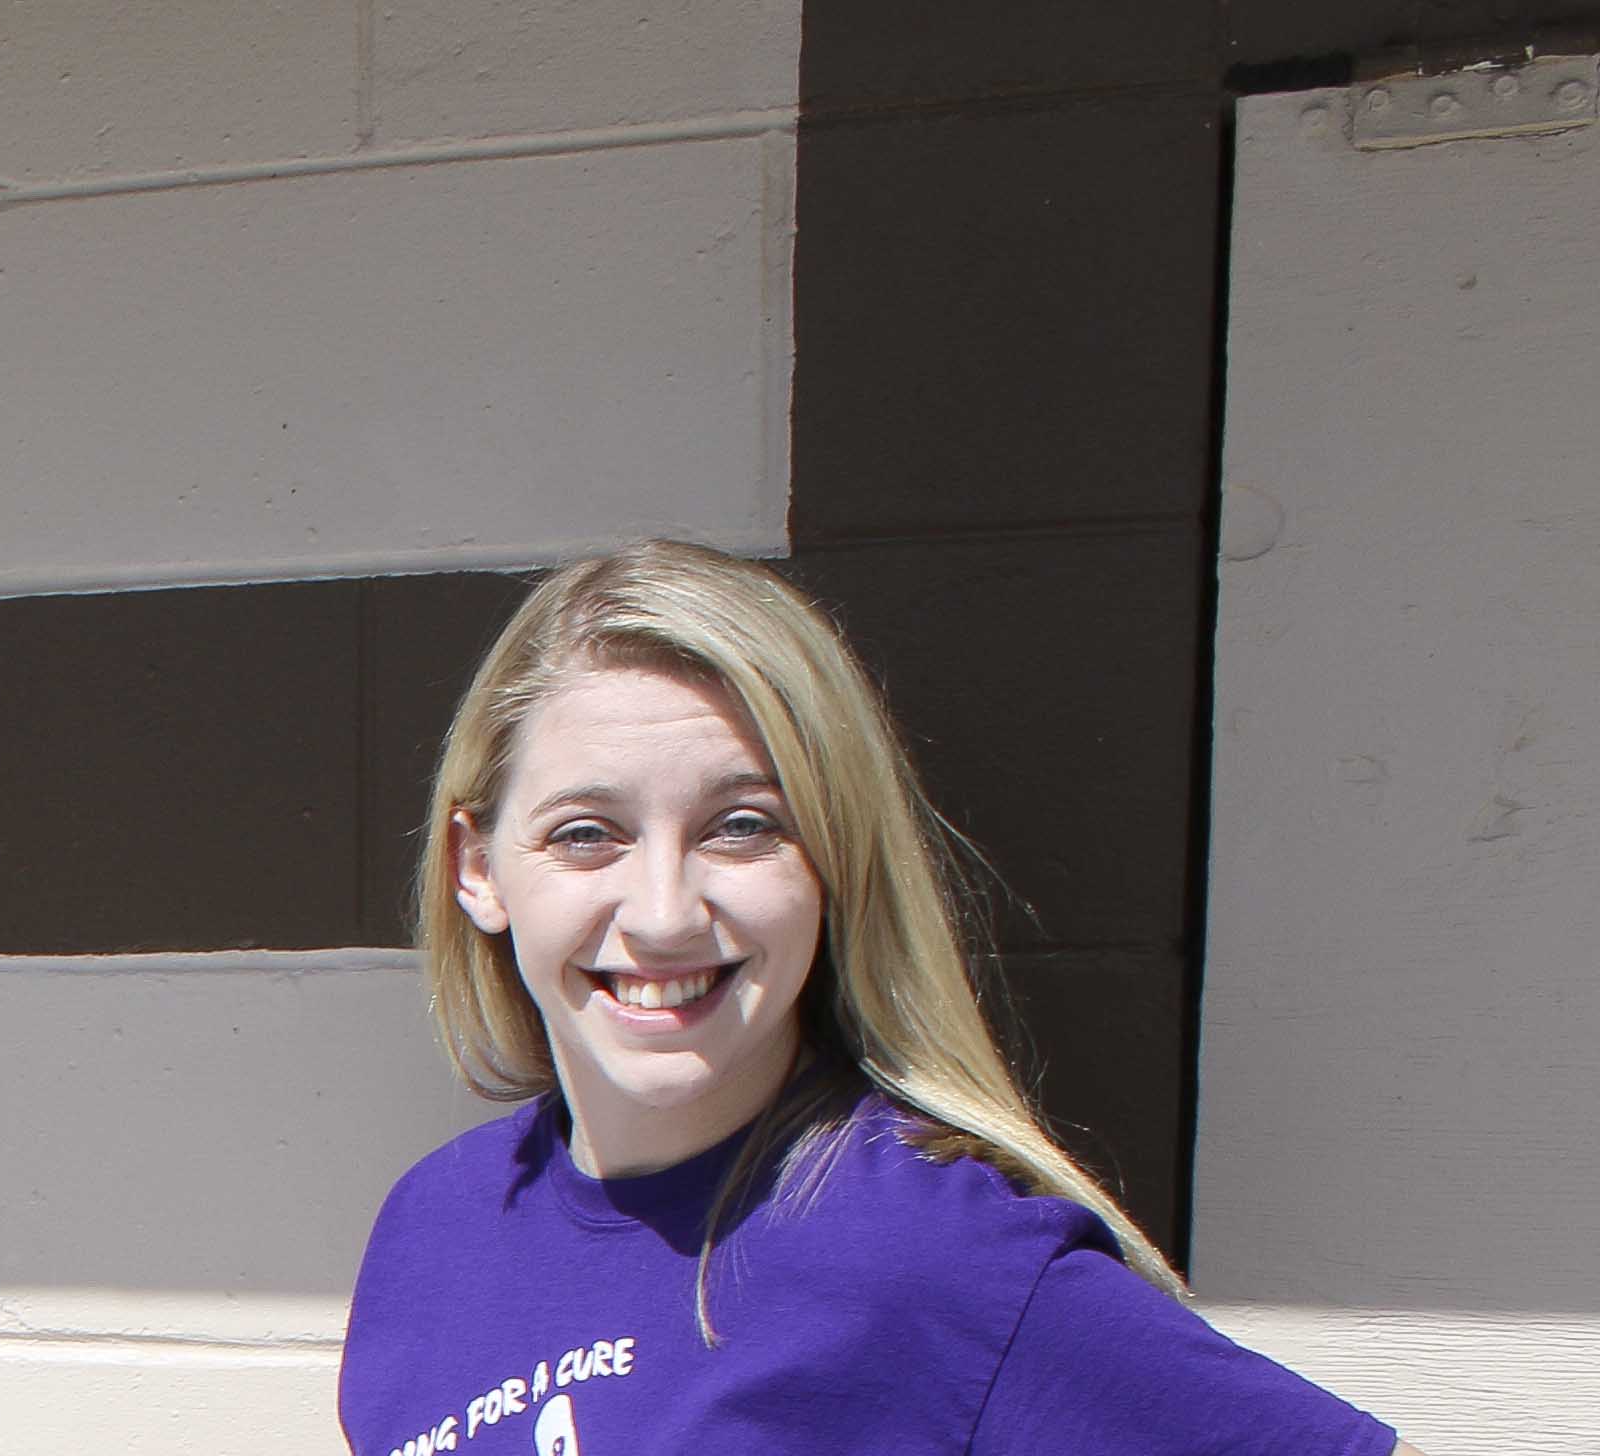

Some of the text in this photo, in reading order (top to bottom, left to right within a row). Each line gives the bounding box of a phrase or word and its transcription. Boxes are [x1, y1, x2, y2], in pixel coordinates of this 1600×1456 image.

[467, 1376, 527, 1440] FOR
[532, 1361, 550, 1402] A
[555, 1336, 636, 1388] CURE
